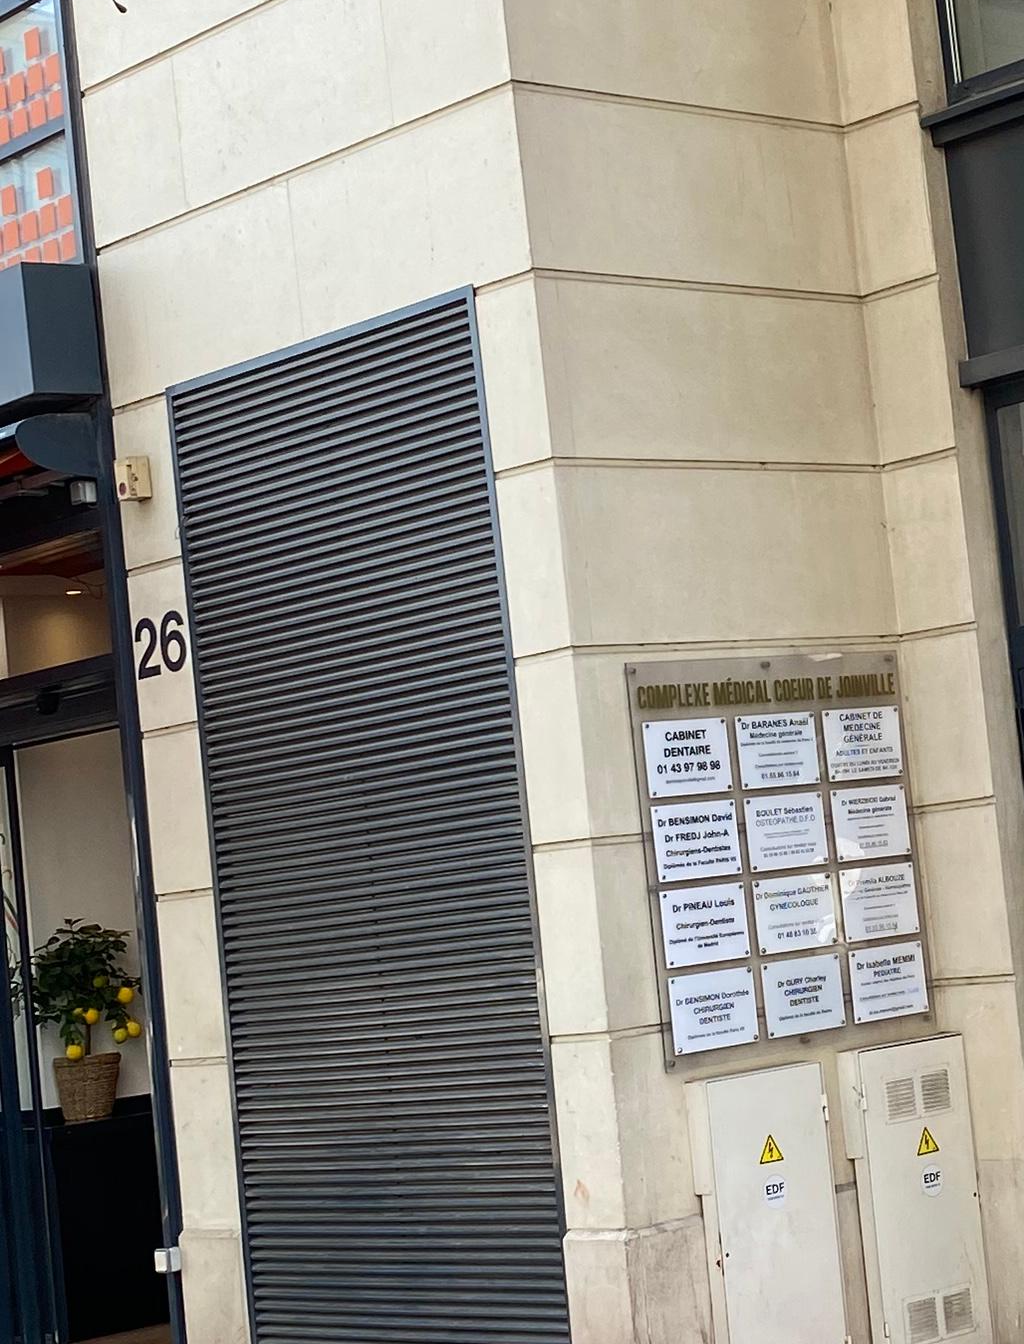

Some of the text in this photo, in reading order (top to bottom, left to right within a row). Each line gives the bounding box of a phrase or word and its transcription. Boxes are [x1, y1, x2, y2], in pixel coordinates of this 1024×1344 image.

[134, 610, 187, 680] 26
[637, 673, 896, 709] COMPLEXE MÉDICAL COEUR DE JOINVILLE
[838, 710, 883, 721] CABINET DE
[740, 721, 750, 729] Dr
[751, 718, 787, 729] BARANES
[664, 728, 707, 741] CABINET
[663, 744, 711, 757] DENTAIRE
[656, 759, 721, 774] 01 43 97 98 98
[657, 811, 732, 827] Dr BENSIMON David
[664, 833, 674, 842] Dr
[675, 831, 701, 841] FREDJ
[755, 892, 762, 900] Dr
[763, 887, 796, 900] Dominique
[672, 896, 735, 912] Dr PINEAU Louis
[856, 961, 865, 970] Dr
[777, 980, 784, 988] Dr
[675, 998, 683, 1006] Dr
[698, 1013, 731, 1025] DENTISTE
[923, 1171, 941, 1184] EDF
[766, 1182, 785, 1196] EDF
